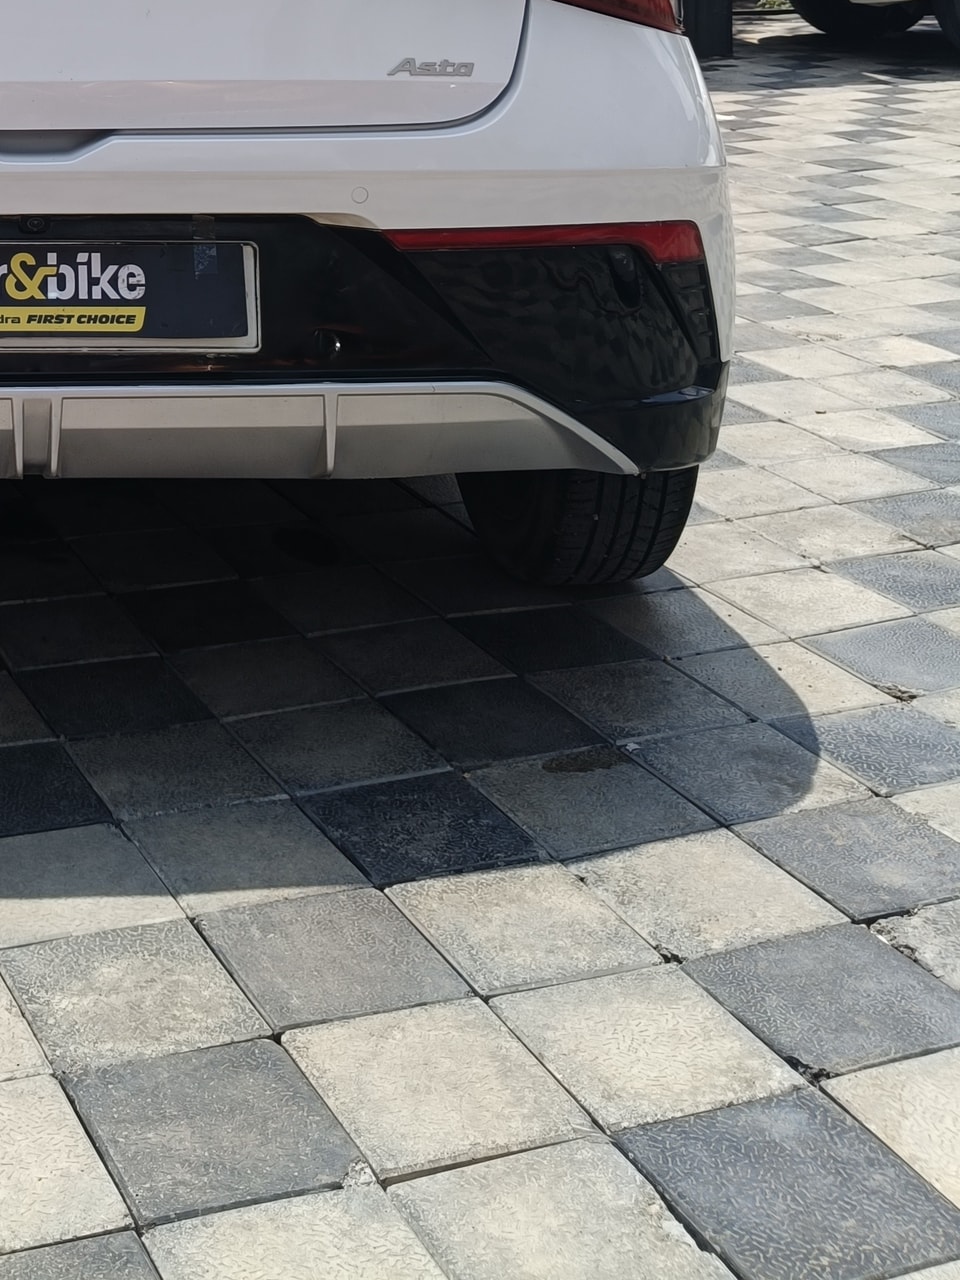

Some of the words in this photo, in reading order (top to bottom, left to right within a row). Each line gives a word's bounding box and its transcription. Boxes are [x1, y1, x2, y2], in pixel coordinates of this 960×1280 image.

[386, 57, 475, 77] Asta
[26, 314, 74, 325] FIRST
[76, 314, 137, 325] CHOICE
